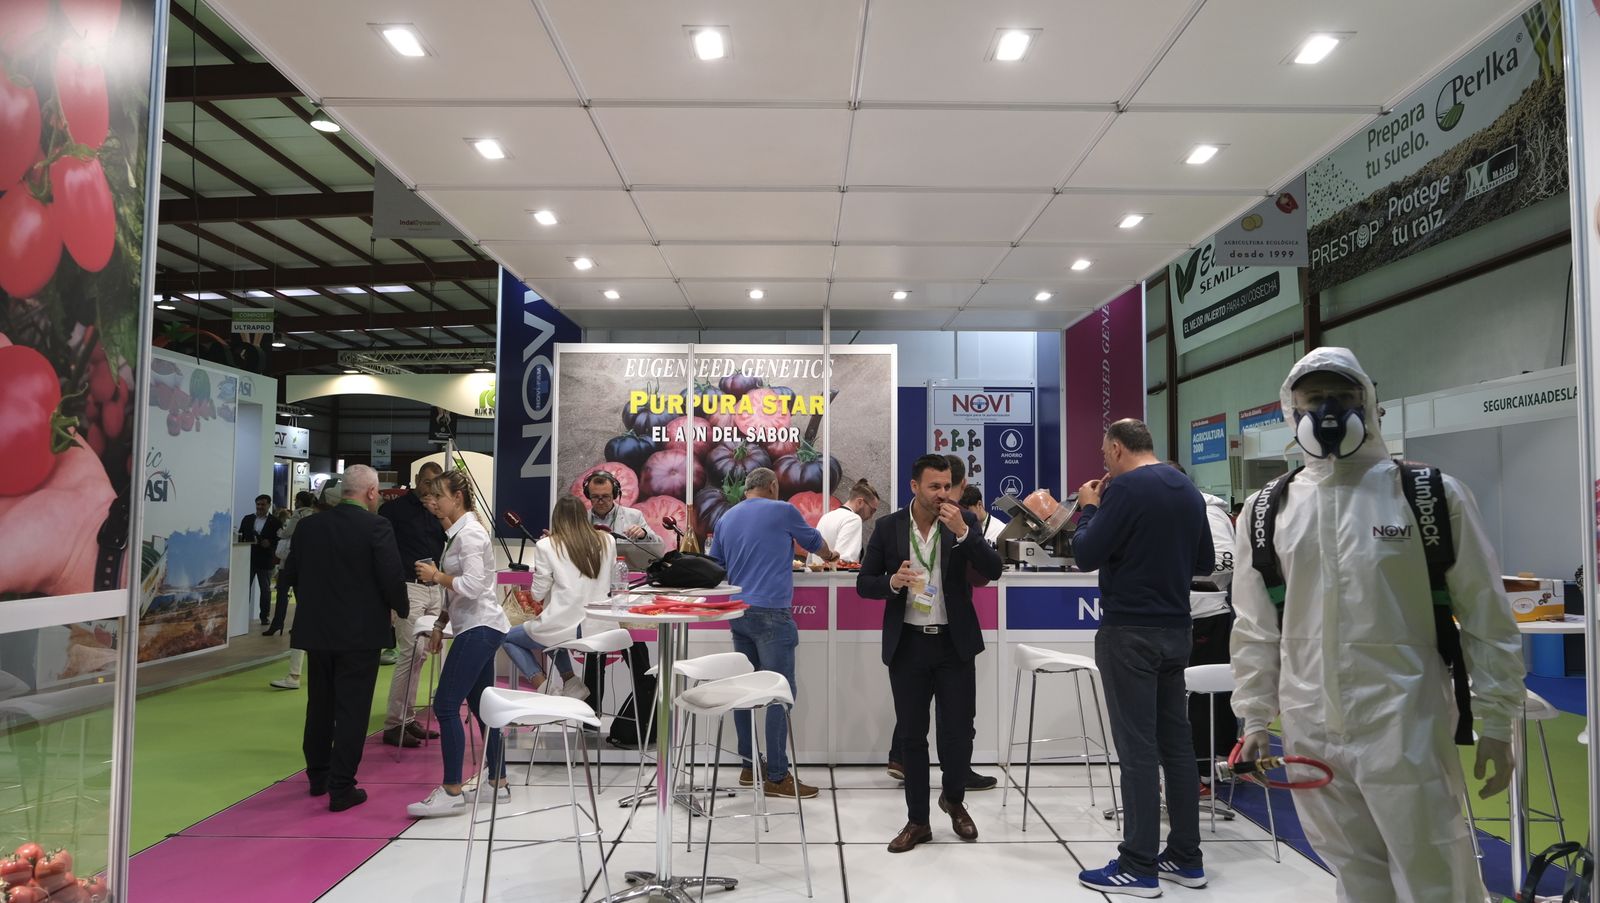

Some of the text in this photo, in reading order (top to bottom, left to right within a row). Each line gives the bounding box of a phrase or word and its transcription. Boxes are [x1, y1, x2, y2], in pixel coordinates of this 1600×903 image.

[1451, 47, 1519, 105] Perlka
[1367, 103, 1425, 153] Prepara
[1365, 131, 1429, 180] tu suelo.
[1387, 175, 1450, 220] Protege
[1391, 223, 1409, 247] tu
[1229, 250, 1295, 259] desde 1999
[1189, 316, 1204, 330] MEJOR
[1203, 305, 1226, 324] INJERTO
[1226, 298, 1240, 314] PARA
[1247, 280, 1278, 305] COSECHA
[762, 394, 825, 416] STAR
[952, 393, 1011, 413] NOVI
[651, 425, 670, 443] EL
[711, 425, 742, 443] DEL
[745, 425, 800, 444] SABOR
[1192, 427, 1225, 443] AGRICULTURA
[144, 479, 168, 502] ASI
[1372, 525, 1413, 537] NOVI
[791, 604, 817, 615] TICS
